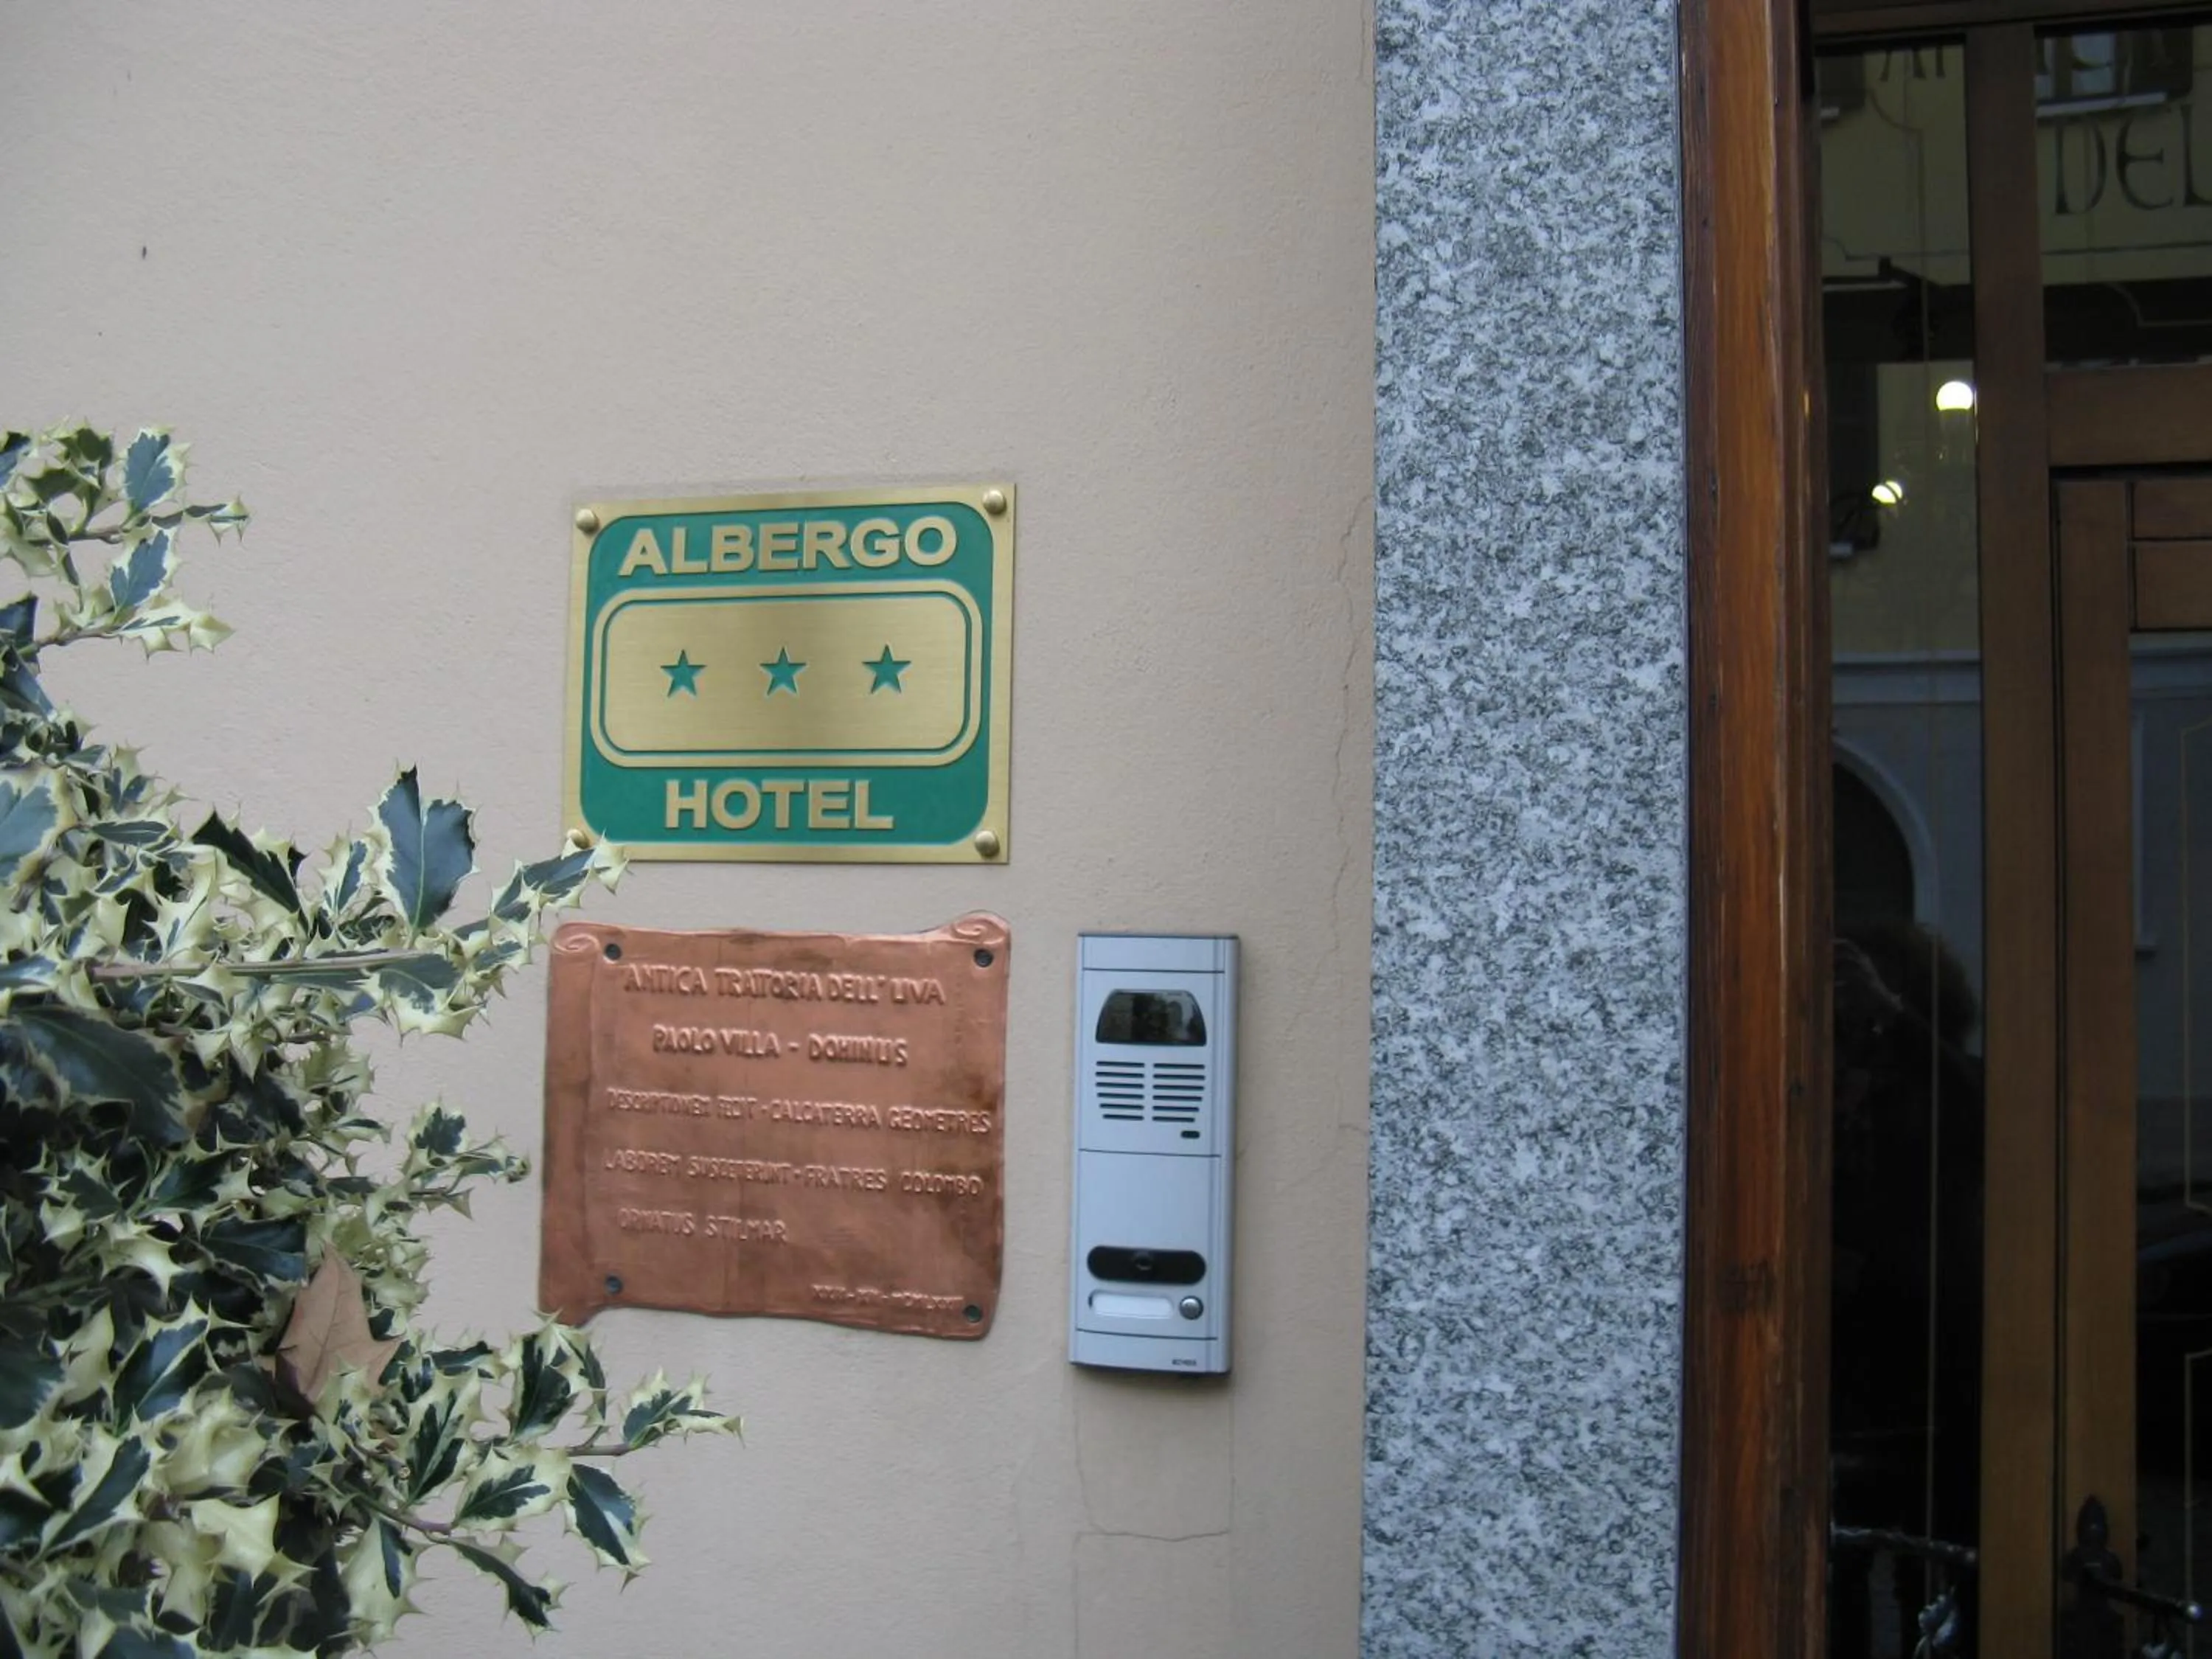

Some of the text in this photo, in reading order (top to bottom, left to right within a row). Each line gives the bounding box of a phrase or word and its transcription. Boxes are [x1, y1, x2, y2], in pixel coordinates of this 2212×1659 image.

[617, 515, 957, 577] ALBERGO
[665, 779, 894, 830] HOTEL
[625, 964, 708, 995] ANTICA
[653, 1023, 717, 1055] PAOLO
[720, 1028, 781, 1058] VILLA
